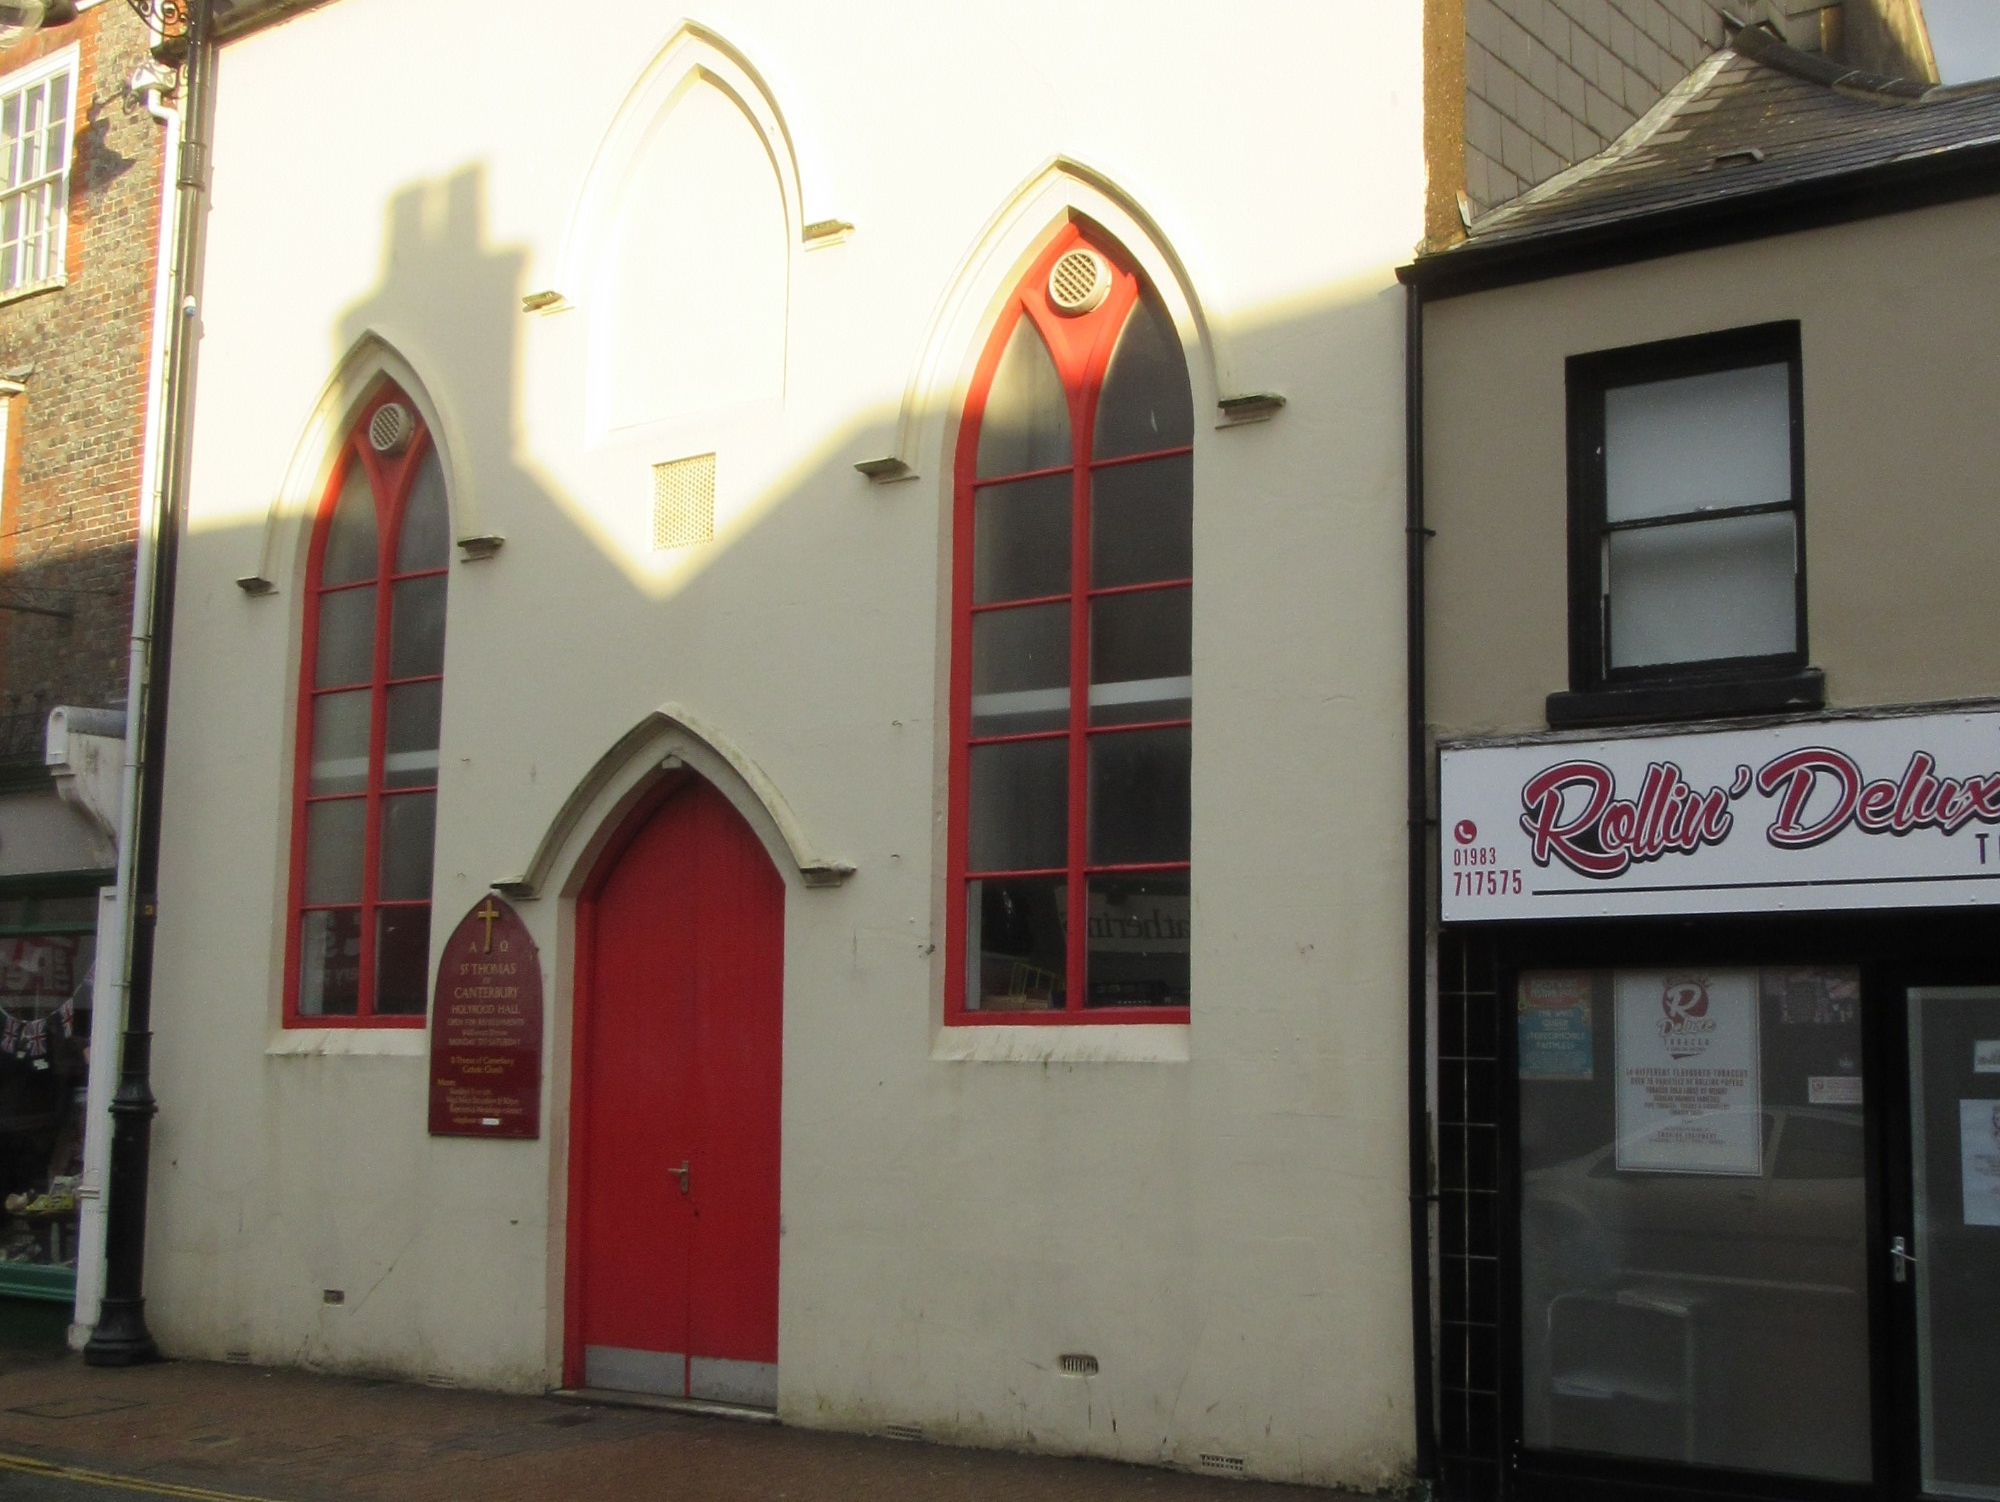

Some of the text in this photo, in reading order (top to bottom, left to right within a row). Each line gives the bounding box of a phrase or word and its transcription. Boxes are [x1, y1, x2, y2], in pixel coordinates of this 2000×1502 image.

[1454, 847, 1496, 866] 01983
[1975, 832, 2000, 865] T
[1454, 869, 1523, 897] 717575
[472, 962, 517, 975] THOMAS
[454, 986, 518, 998] CANTERBURY
[498, 1004, 520, 1014] HALL
